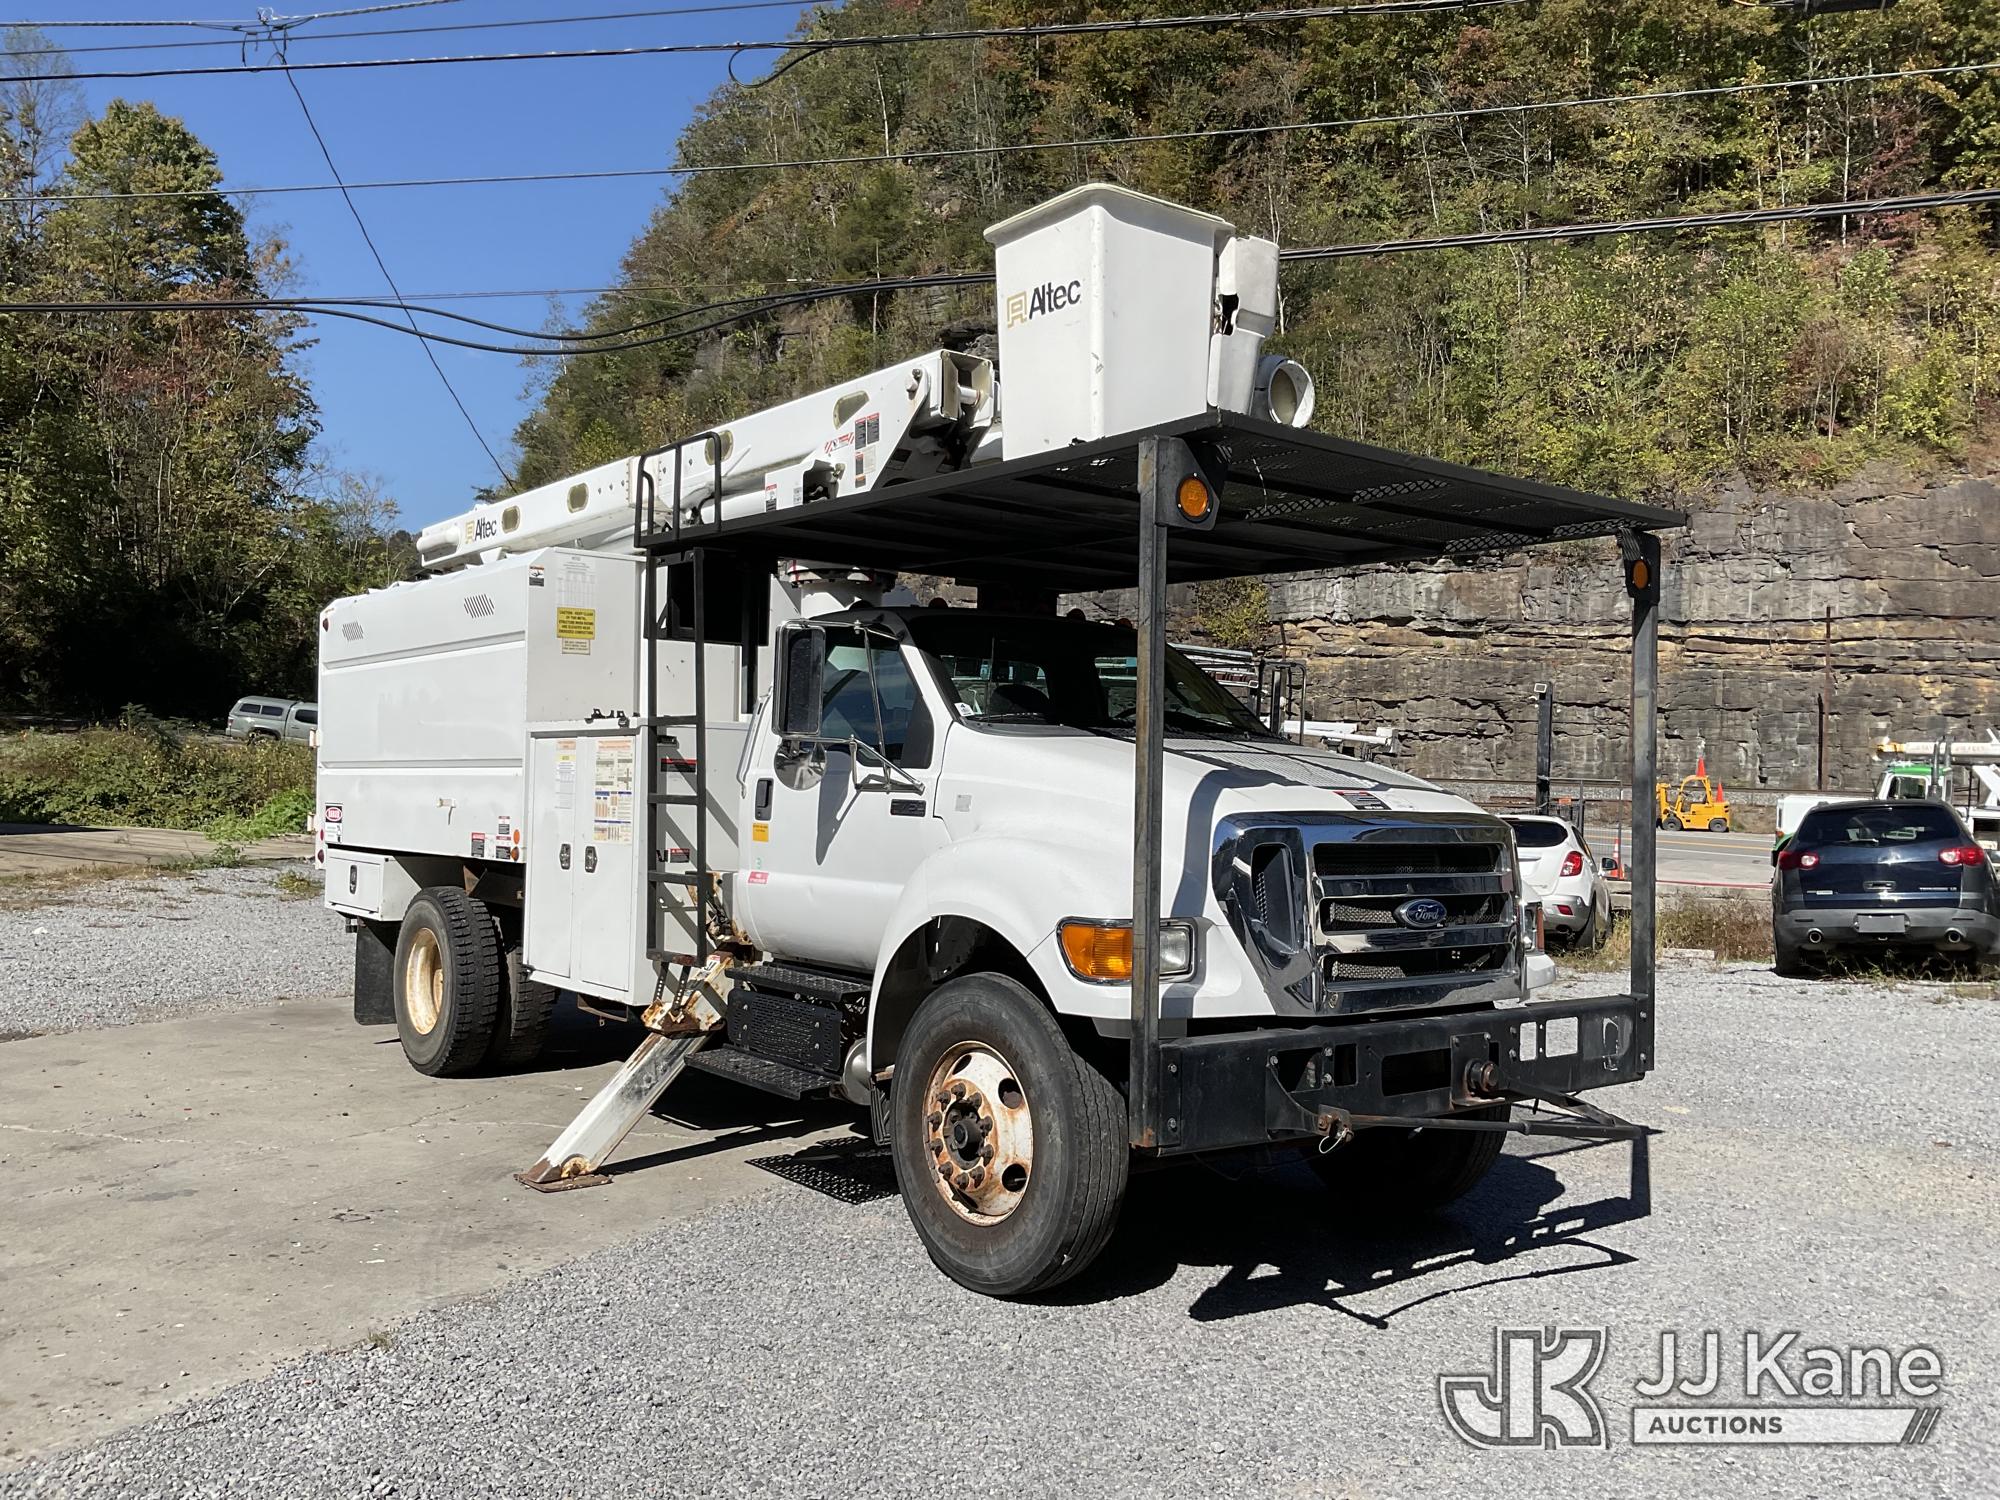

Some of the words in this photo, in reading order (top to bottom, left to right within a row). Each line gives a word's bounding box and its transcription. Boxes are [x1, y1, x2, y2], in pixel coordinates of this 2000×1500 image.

[1029, 280, 1081, 320] Altec
[475, 517, 497, 541] Altec
[1415, 904, 1439, 920] Ford
